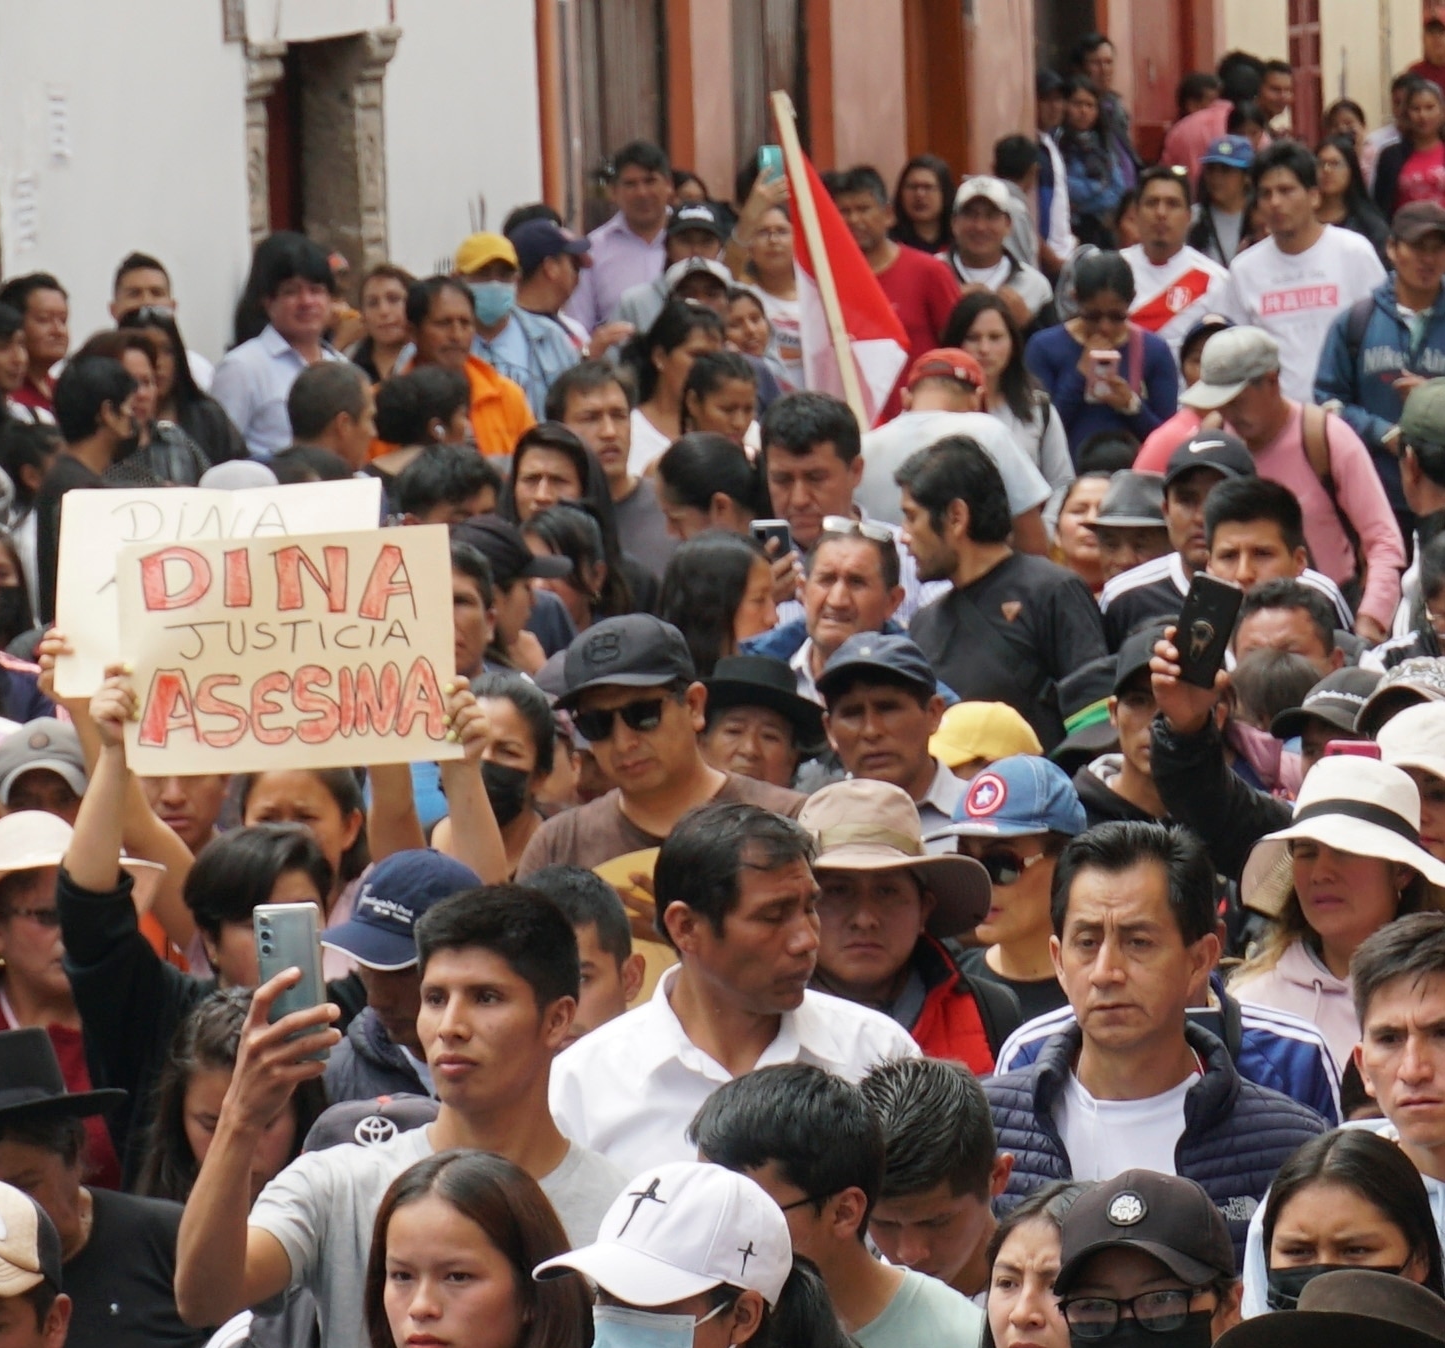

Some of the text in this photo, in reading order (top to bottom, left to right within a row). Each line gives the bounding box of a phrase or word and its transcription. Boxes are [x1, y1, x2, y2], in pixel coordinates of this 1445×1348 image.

[139, 544, 418, 621] DINA
[163, 618, 412, 661] JUSTICIA
[138, 655, 448, 749] ASESINA
